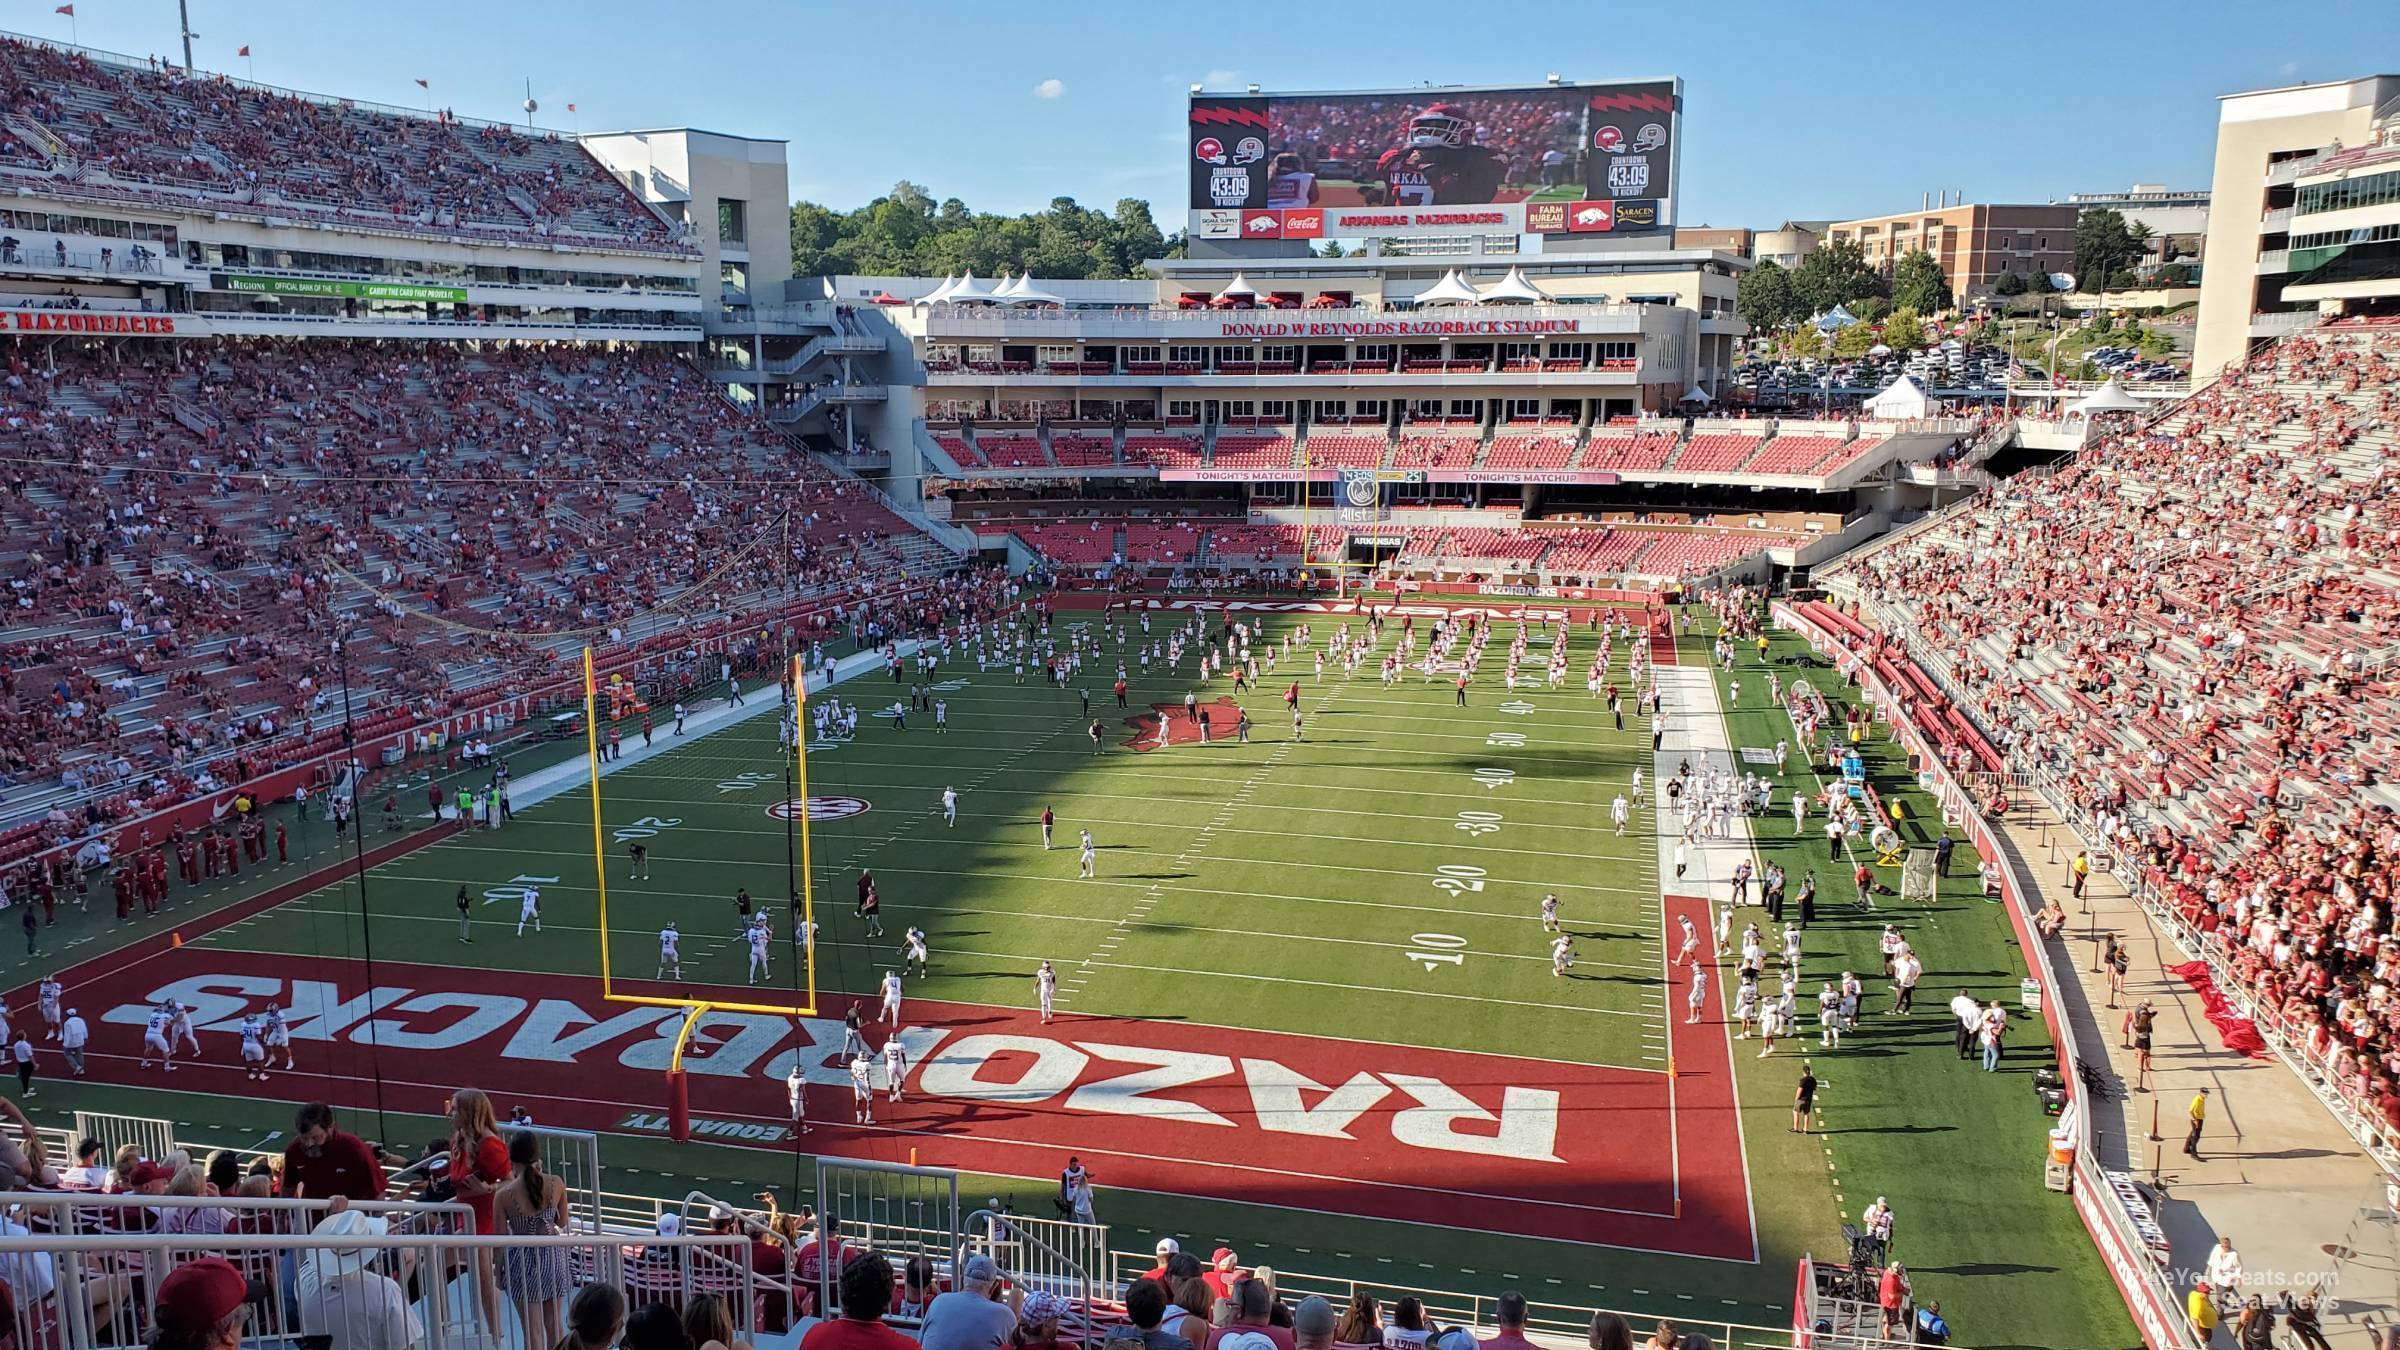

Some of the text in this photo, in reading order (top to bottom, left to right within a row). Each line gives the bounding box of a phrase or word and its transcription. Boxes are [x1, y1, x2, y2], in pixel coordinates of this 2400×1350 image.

[1612, 155, 1647, 164] COUNTDOWN
[1213, 167, 1247, 176] COUNTDOWN
[1610, 166, 1647, 186] 43:09
[1212, 177, 1247, 196] 43:09
[1620, 187, 1643, 196] KICKOFF
[1223, 198, 1244, 206] KICKOFF
[1540, 205, 1563, 214] FARM
[1287, 217, 1320, 230] Coca-Cola
[1339, 213, 1505, 227] ARKANSAS RAZORBACKS
[1529, 213, 1563, 222] BUREAU
[275, 282, 298, 291] OFFICIAL
[299, 284, 314, 292] BANK
[322, 285, 333, 293] THE
[369, 287, 387, 296] CARRY
[388, 287, 399, 296] THE
[400, 288, 414, 297] CARD
[415, 289, 428, 297] THAT
[17, 313, 175, 333] RAZORBACKS
[1222, 320, 1577, 335] DONALD W REYNOLDS RAZORBACK STADIUM
[1195, 472, 1303, 480] TONIGHT'S MATCHUP
[1346, 471, 1373, 480] 43:09
[1464, 474, 1577, 483] TONIGHT'S MATCHUP
[1354, 537, 1401, 547] ARKANSAS
[1478, 585, 1558, 598] RAZORBACKS
[1486, 732, 1527, 747] 50
[1472, 768, 1516, 786] 40
[612, 816, 683, 840] 20
[1454, 811, 1503, 833] 30
[1431, 865, 1487, 893] 20
[1405, 933, 1468, 966] 10
[102, 973, 1568, 1165] RAZORBACKS
